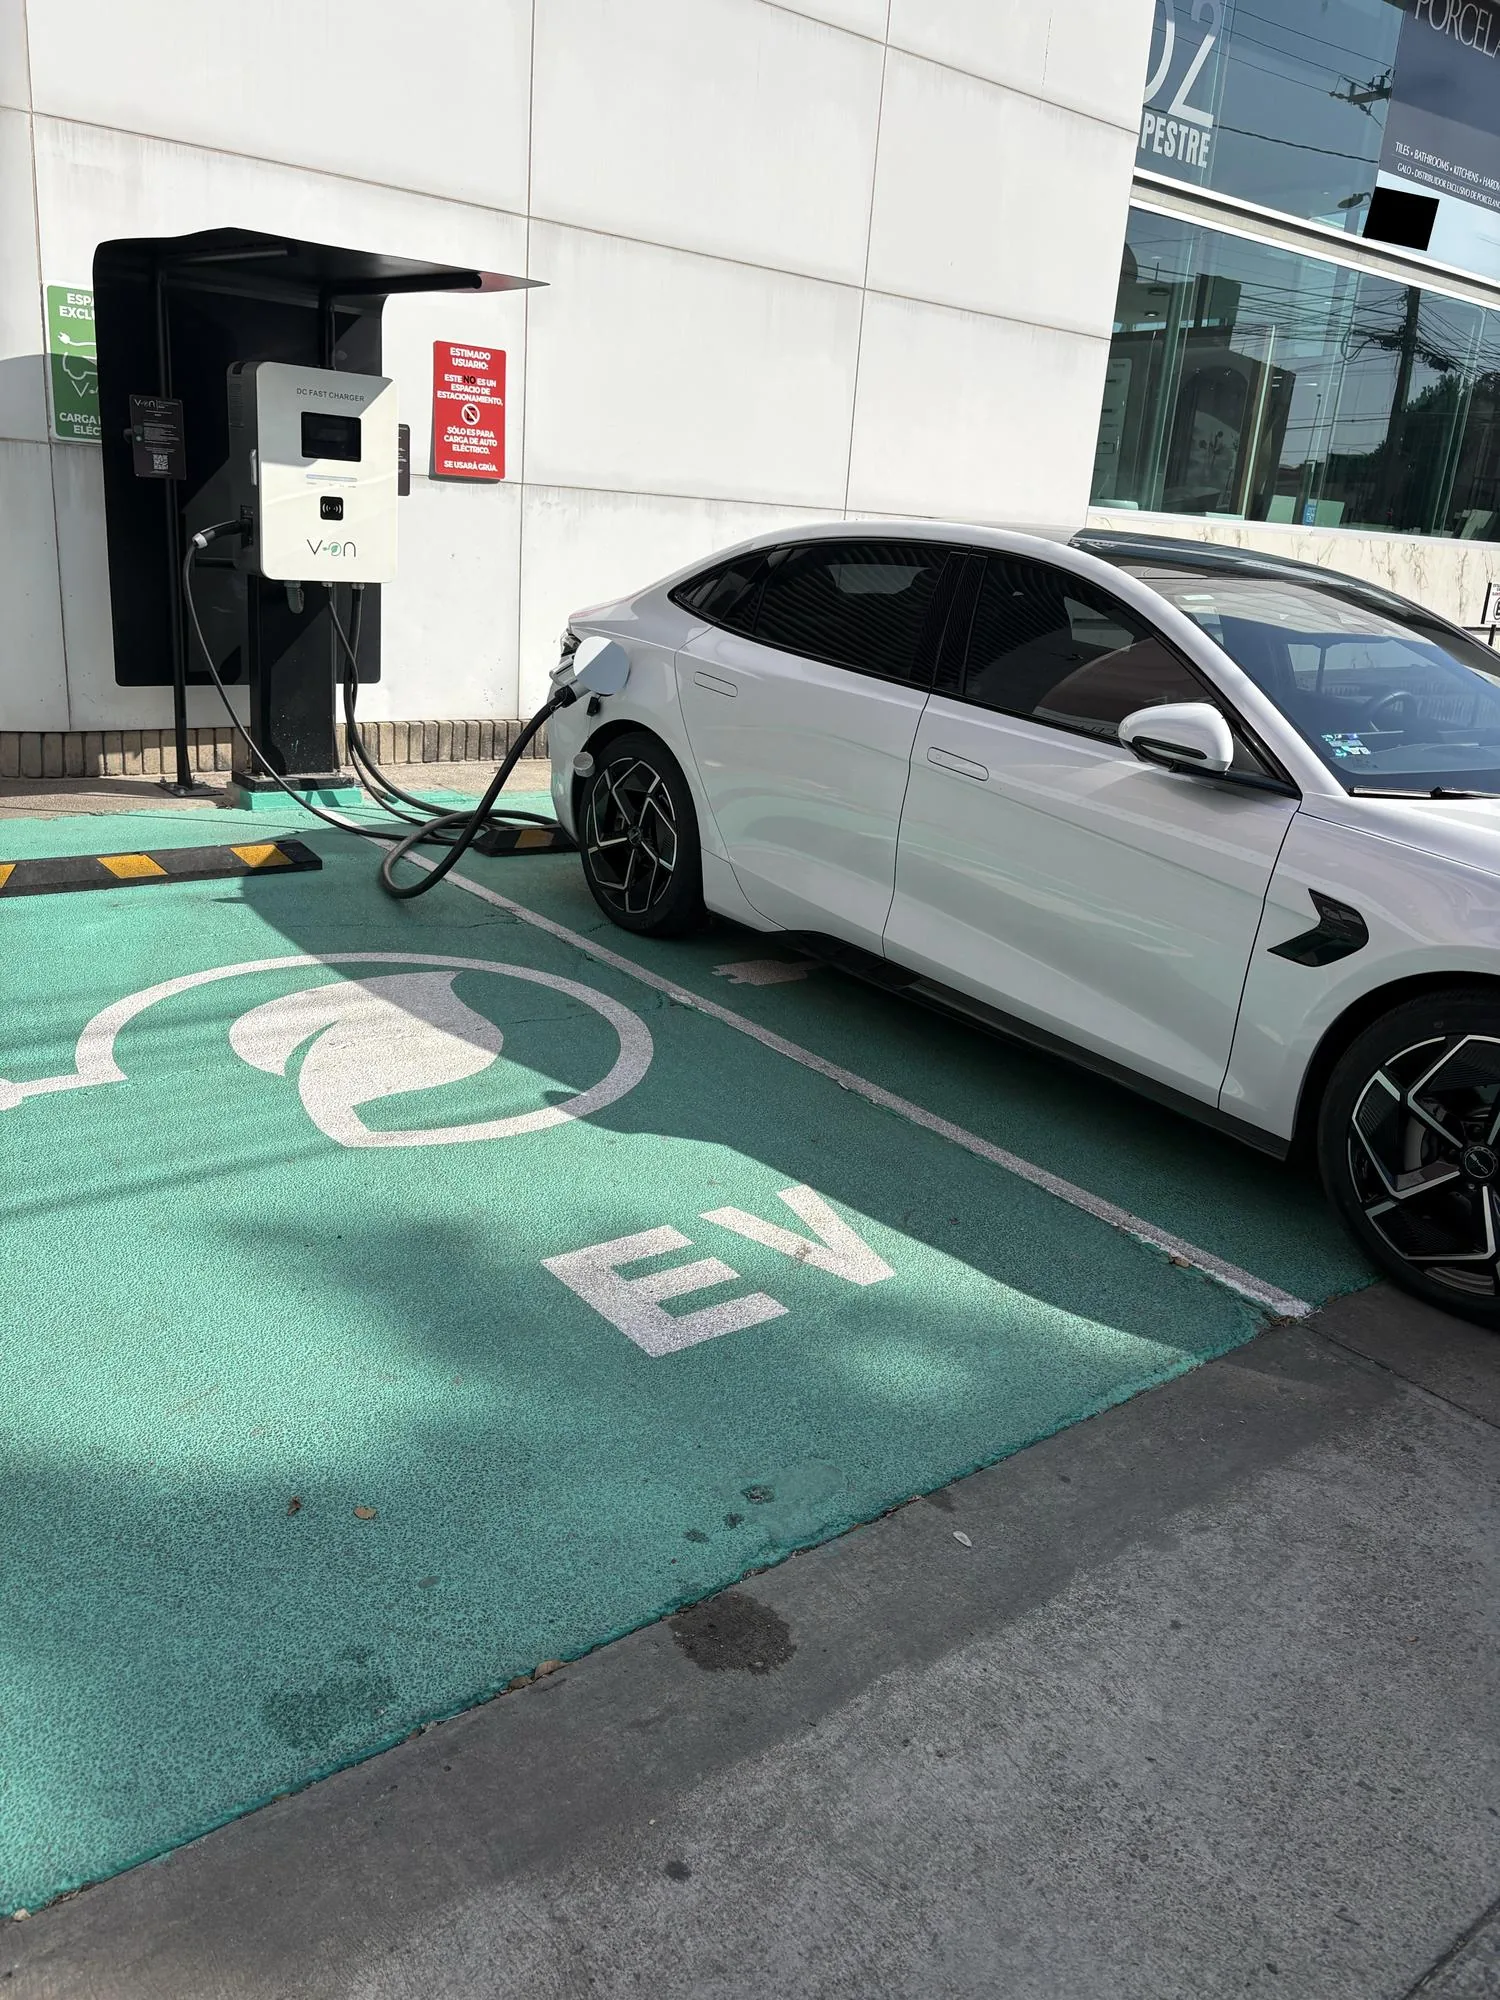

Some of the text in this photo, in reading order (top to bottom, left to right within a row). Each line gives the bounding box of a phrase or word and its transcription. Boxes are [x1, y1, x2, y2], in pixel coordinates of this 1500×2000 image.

[1140, 112, 1212, 169] PESTRE
[1395, 141, 1411, 156] TILES
[1414, 149, 1450, 172] BATHROOMS
[1453, 165, 1480, 183] KITCHENS
[1470, 190, 1478, 200] DE
[450, 347, 491, 360] ESTIMADO
[452, 358, 489, 370] USUARIO:
[444, 374, 496, 387] ESTE NO ES UN
[296, 387, 365, 402] DC FAST CHARGER
[451, 384, 490, 395] ESPACIO DE
[59, 412, 97, 425] CARGA
[447, 426, 466, 434] SÓLO
[476, 430, 494, 438] PARA
[443, 435, 468, 444] CARGA
[479, 439, 498, 447] AUTO
[444, 460, 453, 468] SE
[540, 1184, 896, 1358] EV
